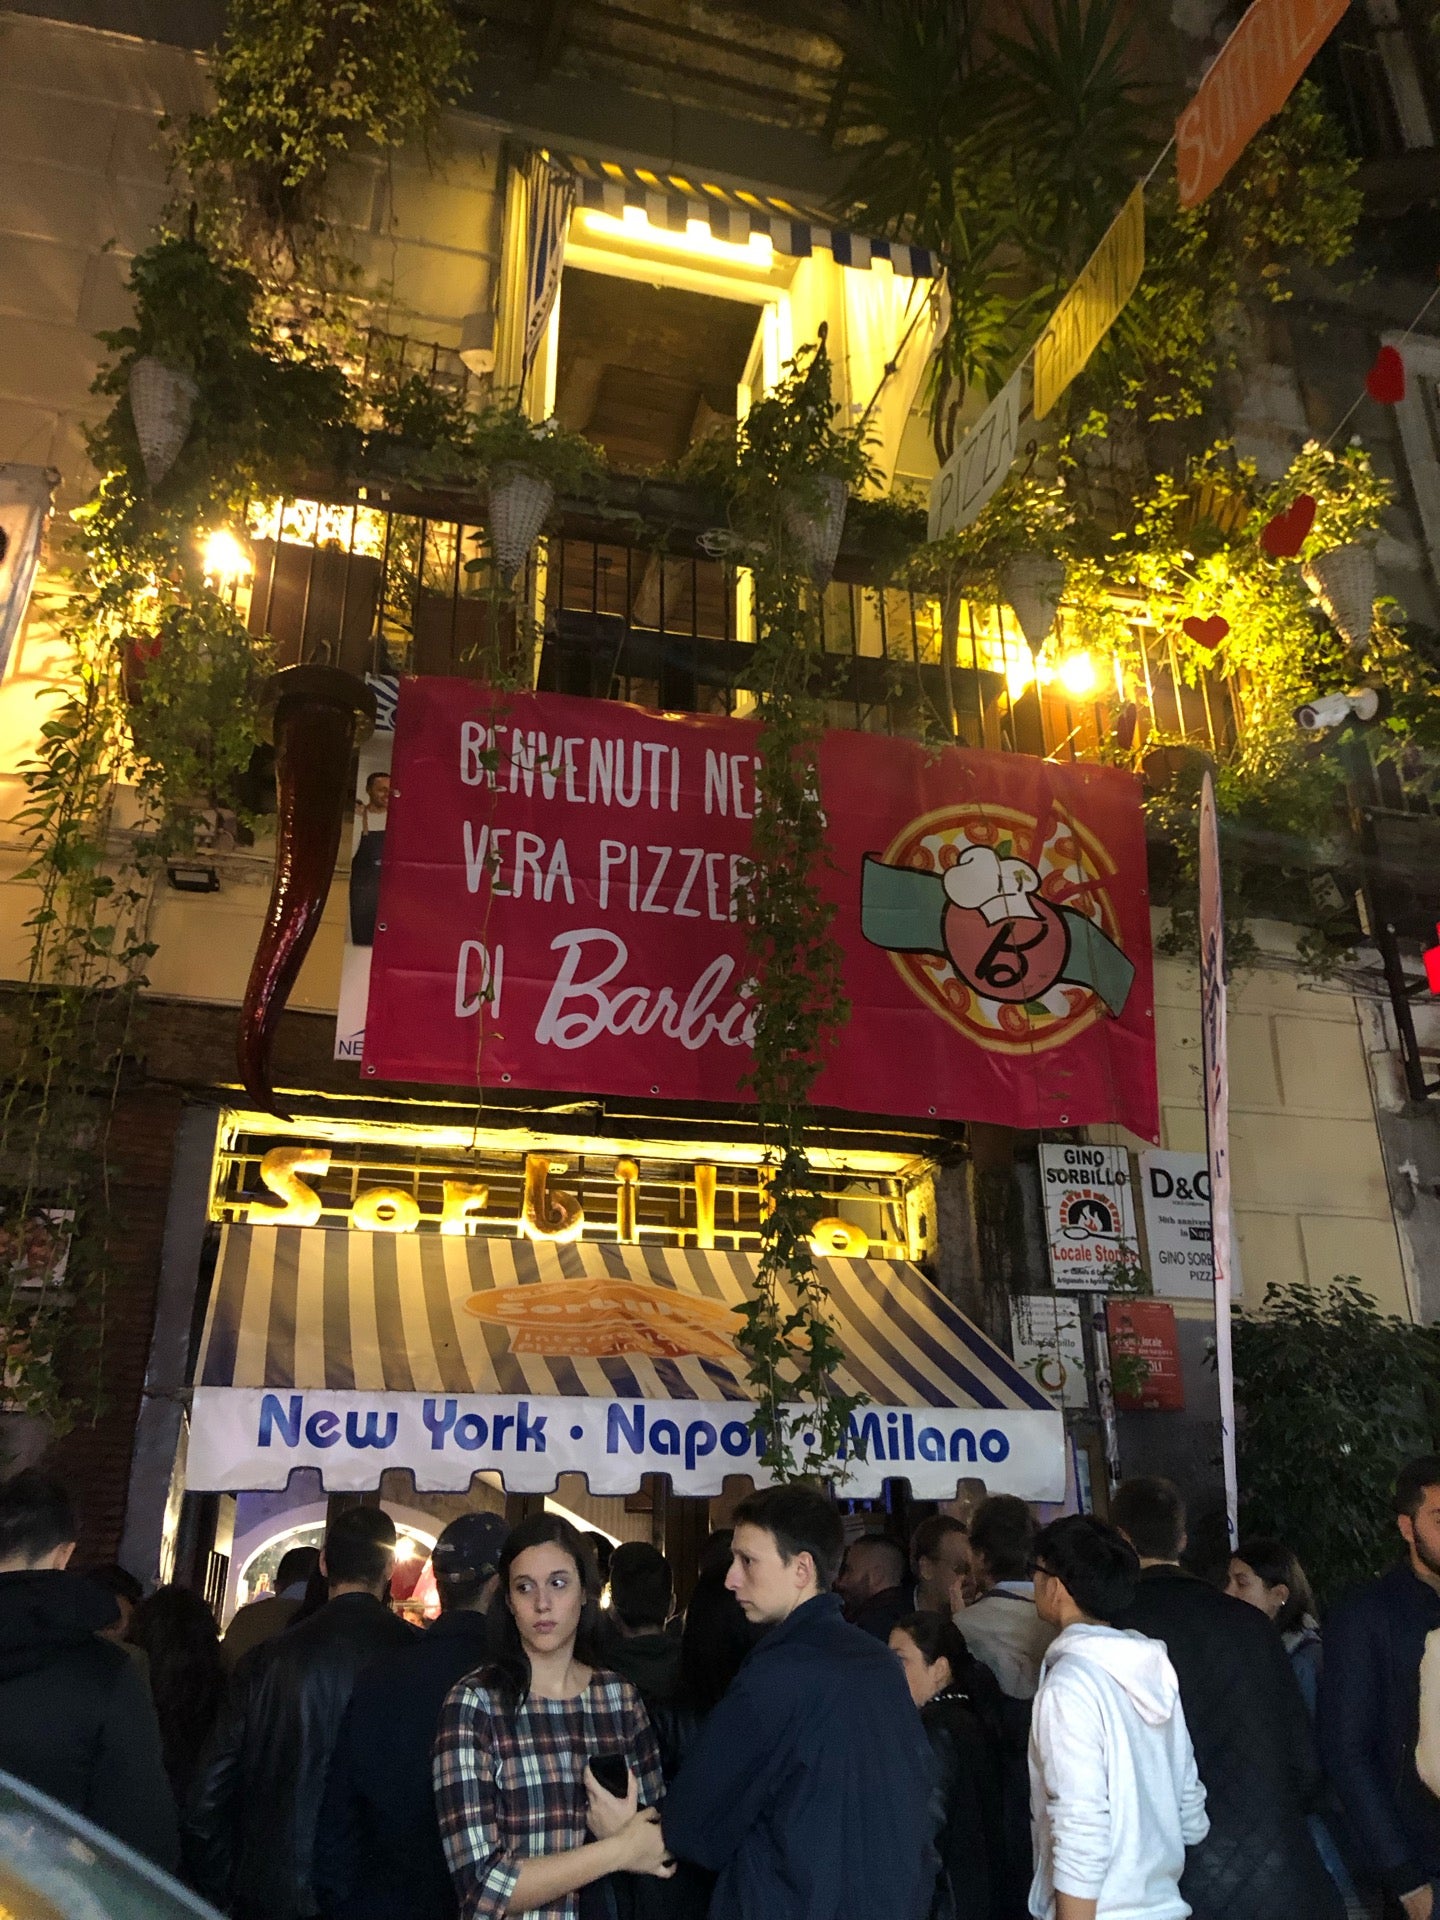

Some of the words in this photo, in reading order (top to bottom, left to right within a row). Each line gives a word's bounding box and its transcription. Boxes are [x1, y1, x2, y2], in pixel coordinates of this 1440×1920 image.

[935, 397, 1013, 540] PIZZA
[460, 720, 680, 813] BENVENUTI
[463, 820, 576, 905] VERA
[455, 940, 504, 1019] DI
[1046, 1167, 1126, 1186] SORBILLO
[1064, 1149, 1104, 1167] GINO
[1053, 1244, 1093, 1262] Locale
[1159, 1250, 1186, 1265] GINO
[1189, 1270, 1213, 1282] PIZZ
[257, 1394, 399, 1450] New
[422, 1398, 548, 1453] York
[836, 1411, 1011, 1464] Milano
